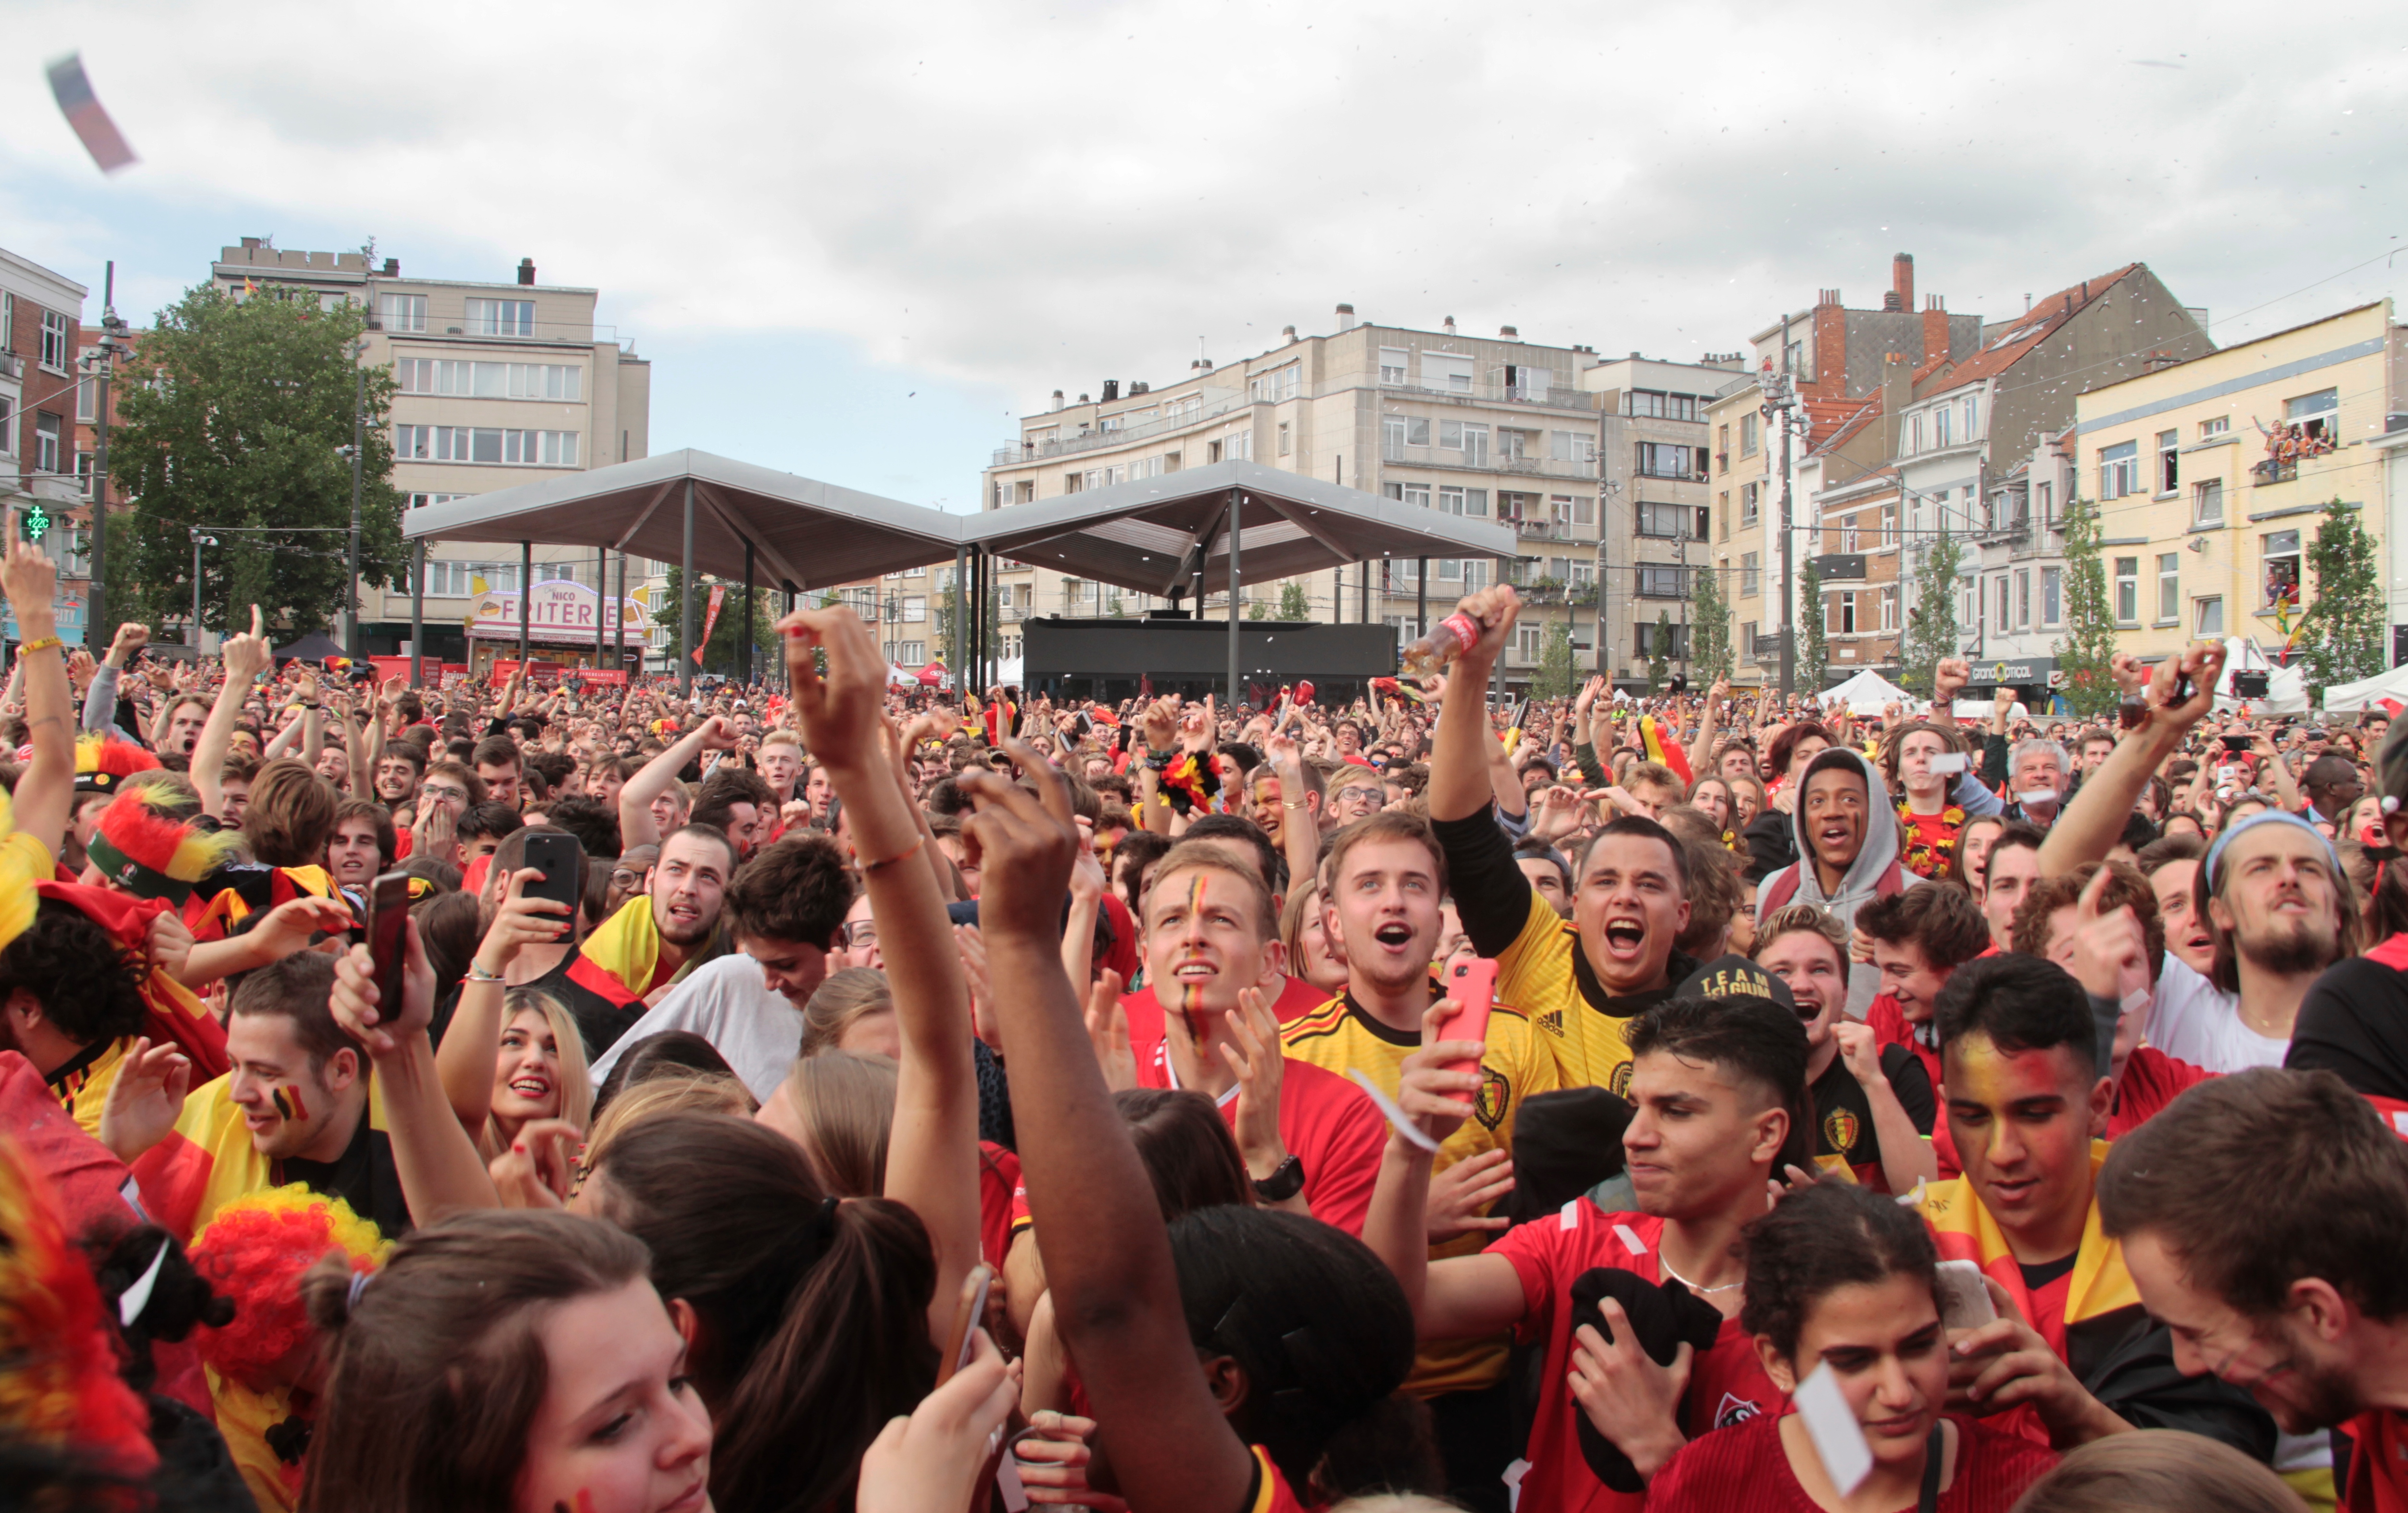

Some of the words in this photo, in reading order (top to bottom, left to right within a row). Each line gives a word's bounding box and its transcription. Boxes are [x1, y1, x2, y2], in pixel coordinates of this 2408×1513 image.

[552, 592, 575, 601] NICO
[502, 600, 617, 625] FRITERE
[1700, 968, 1769, 993] TEAM
[1702, 981, 1773, 1000] ELGIUM
[1537, 1017, 1564, 1038] adidas
